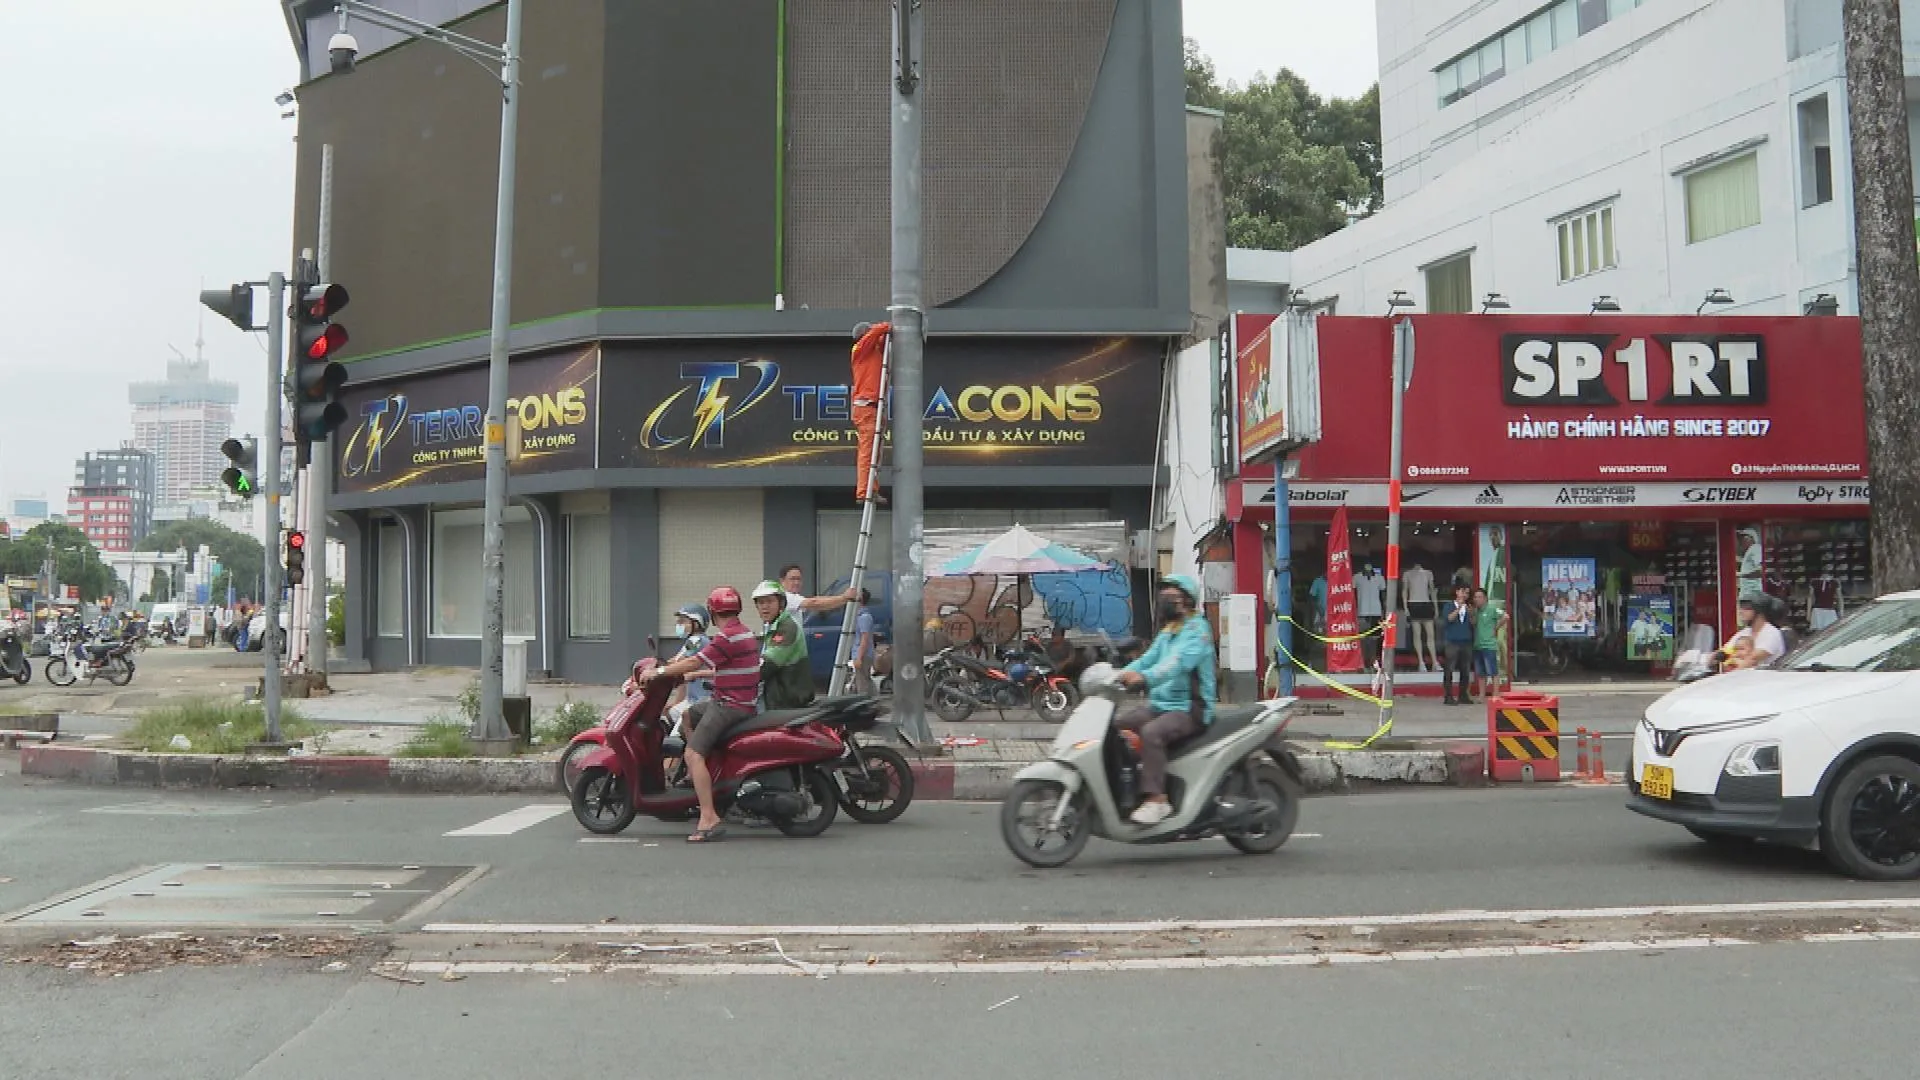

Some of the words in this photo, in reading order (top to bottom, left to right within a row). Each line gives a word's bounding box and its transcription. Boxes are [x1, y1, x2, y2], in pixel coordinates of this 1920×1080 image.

[782, 385, 1102, 422] TEACONS
[408, 387, 586, 447] TERRONS
[1507, 414, 1559, 438] HÀNG
[1564, 414, 1616, 438] CHÍNH
[1620, 416, 1669, 438] HÃNG
[1673, 420, 1723, 436] SINCE
[1727, 420, 1770, 436] 2007
[792, 427, 840, 442] CÔNG
[987, 430, 995, 441] &
[1002, 427, 1034, 441] XÂY
[524, 436, 543, 449] XÂY
[412, 446, 437, 463] CÔNG
[439, 449, 450, 462] TY
[452, 446, 476, 460] TNHH
[1571, 485, 1636, 494] STRONGER
[1706, 487, 1757, 501] CYBEX
[1571, 495, 1636, 504] TOGETHER
